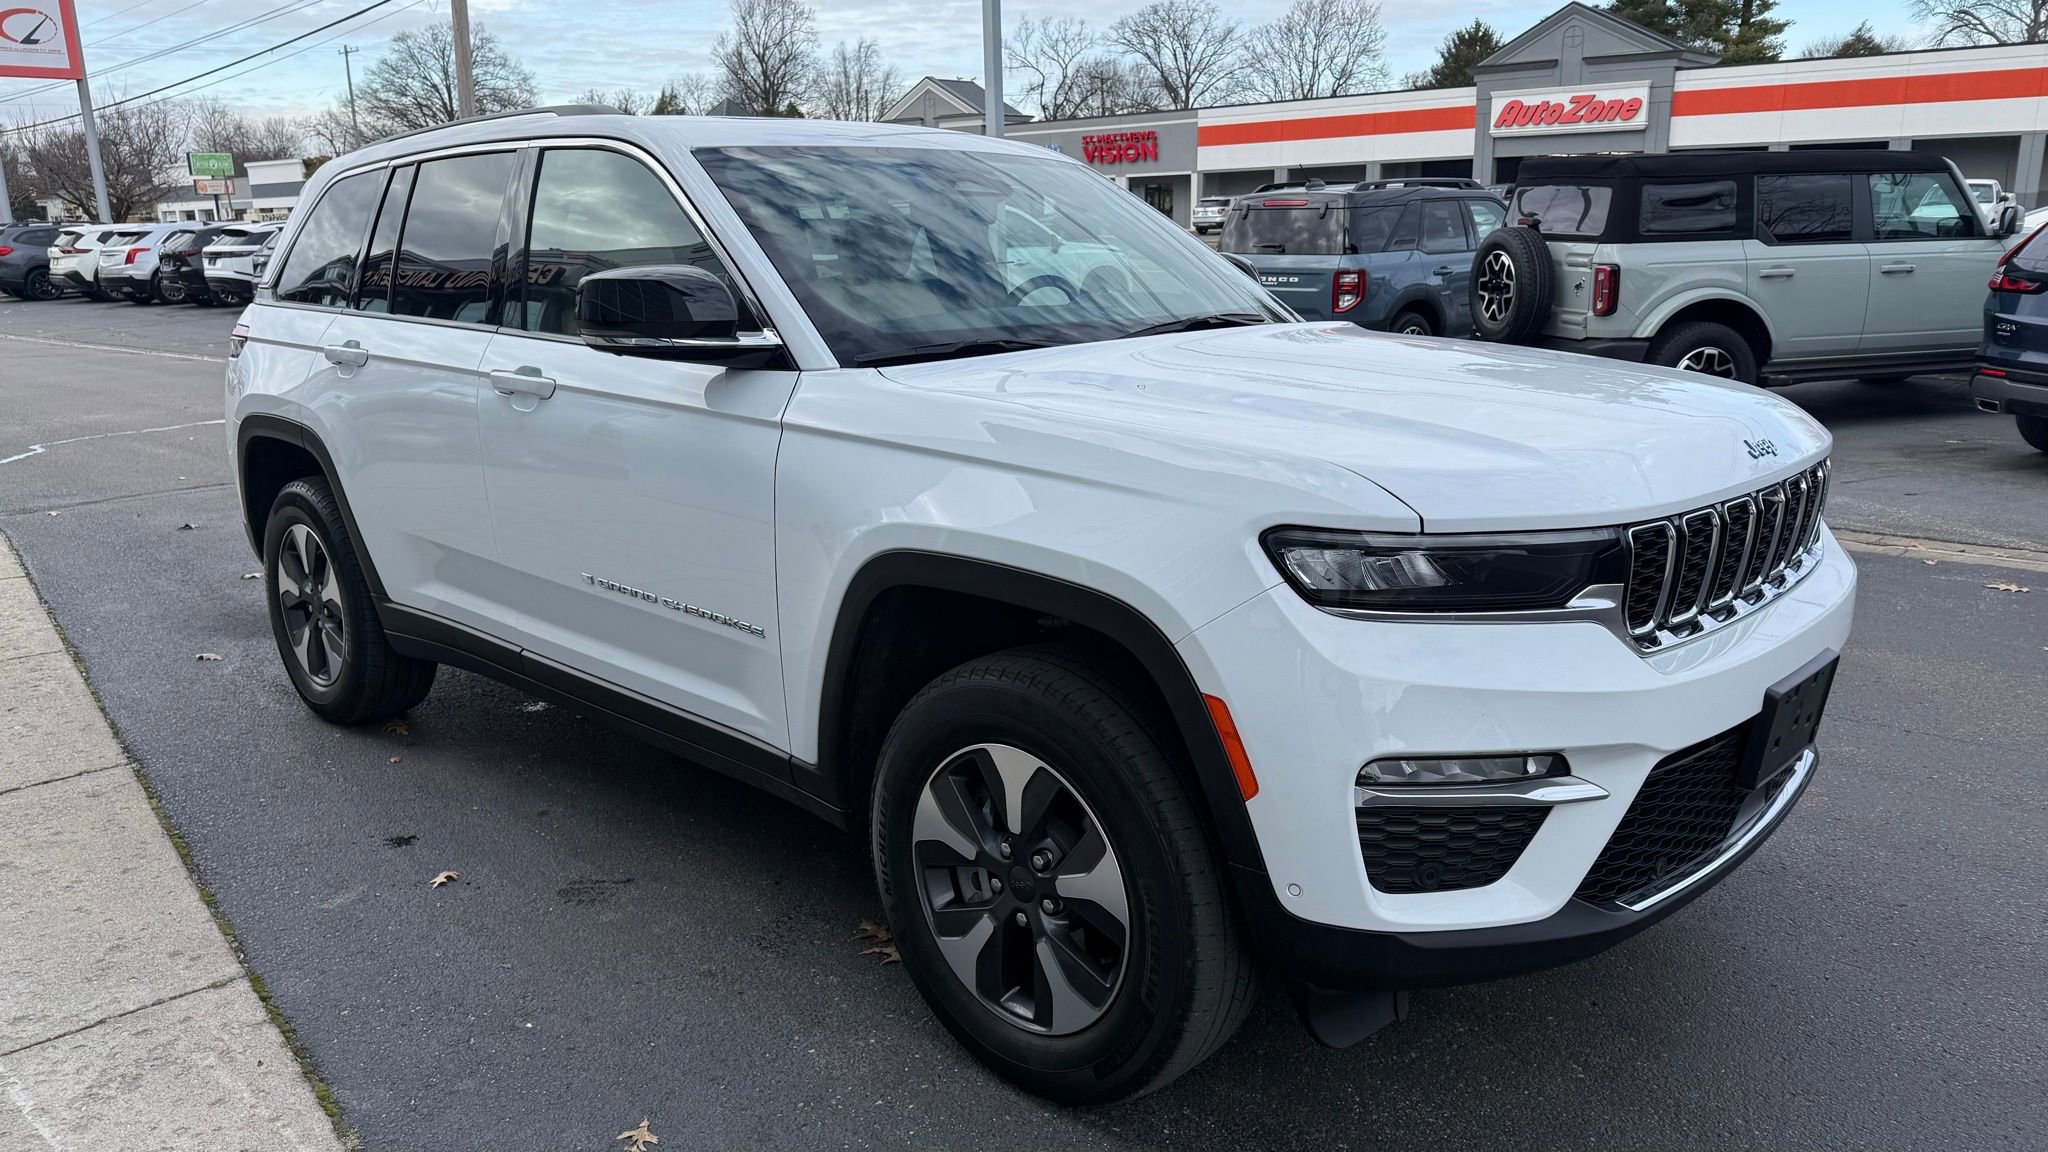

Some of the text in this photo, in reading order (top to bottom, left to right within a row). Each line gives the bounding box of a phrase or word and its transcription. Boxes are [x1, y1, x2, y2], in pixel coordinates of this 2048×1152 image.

[1493, 94, 1643, 128] AutoZone
[1096, 131, 1158, 144] MATTHEWS
[1082, 143, 1158, 164] VISION
[1743, 439, 1779, 460] Jeep
[597, 577, 766, 639] GRAND CHEROKEE
